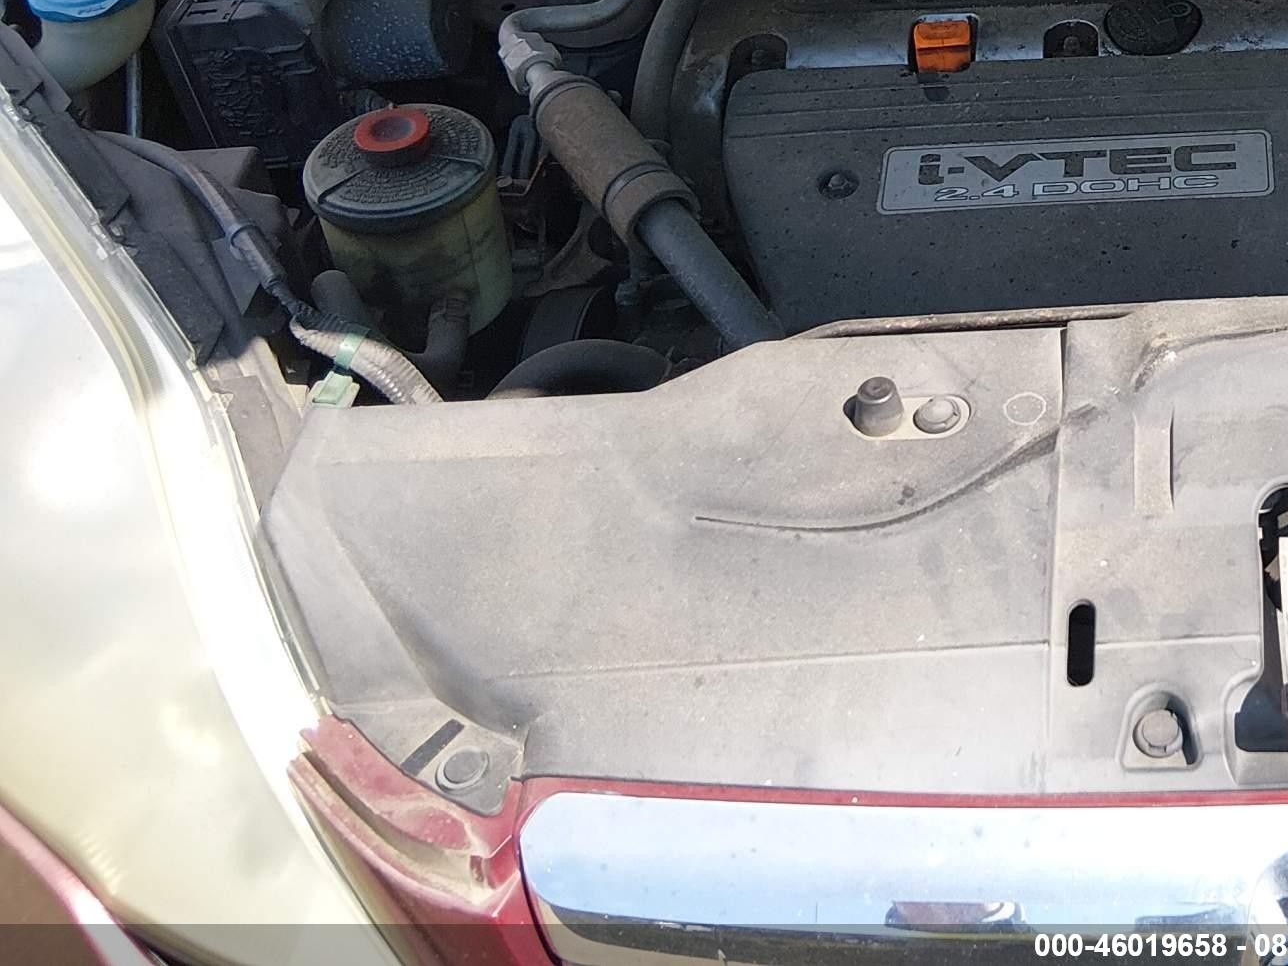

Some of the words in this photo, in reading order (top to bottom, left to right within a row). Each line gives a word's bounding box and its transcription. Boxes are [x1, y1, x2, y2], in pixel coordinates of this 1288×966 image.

[918, 143, 1237, 185] i-VTEC
[934, 183, 1020, 201] 2.4
[1031, 175, 1220, 197] DOHC
